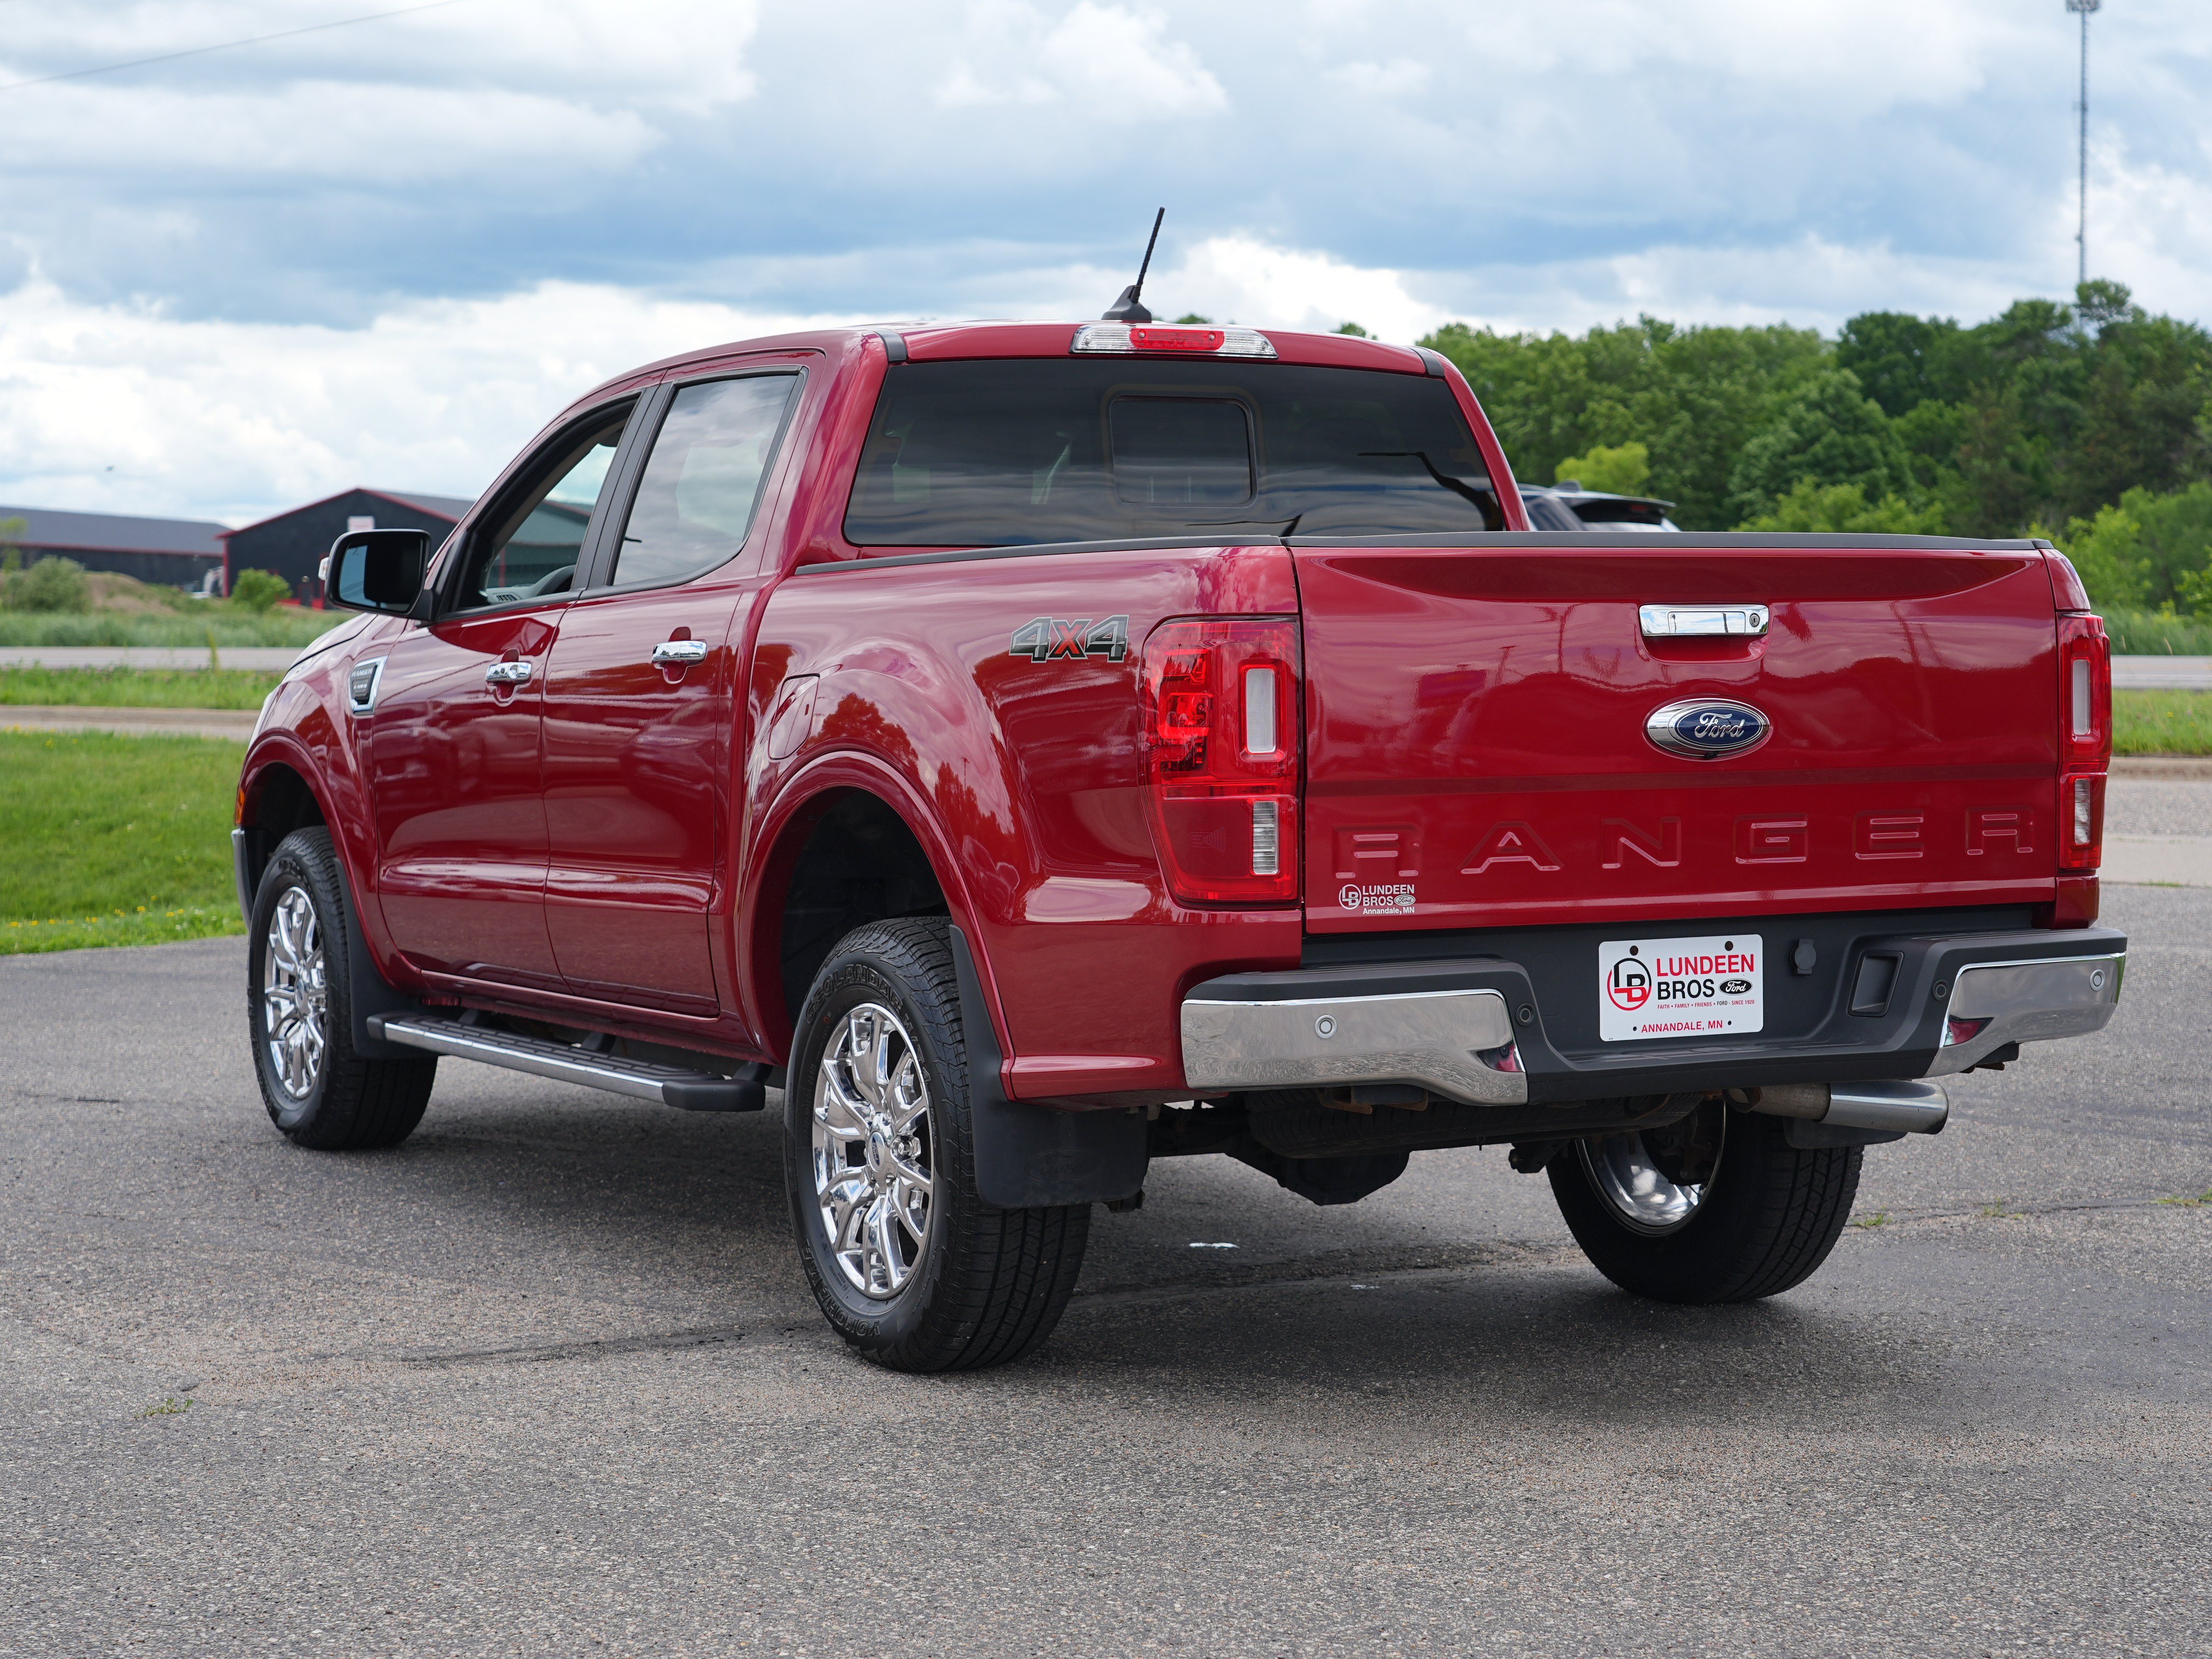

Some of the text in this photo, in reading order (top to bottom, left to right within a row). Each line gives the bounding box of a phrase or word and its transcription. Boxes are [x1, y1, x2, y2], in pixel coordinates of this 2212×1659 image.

[352, 668, 373, 677] RANGER
[1695, 712, 1745, 738] Ford
[1332, 805, 2036, 879] RANGER
[1363, 885, 1414, 895] LUNDEEN
[1363, 896, 1393, 906] BROS
[1656, 954, 1754, 976] LUNDEEN
[1657, 979, 1715, 1000] BROS
[1725, 981, 1746, 993] Ford
[1642, 1020, 1723, 1033] ANNANDALE, MN
